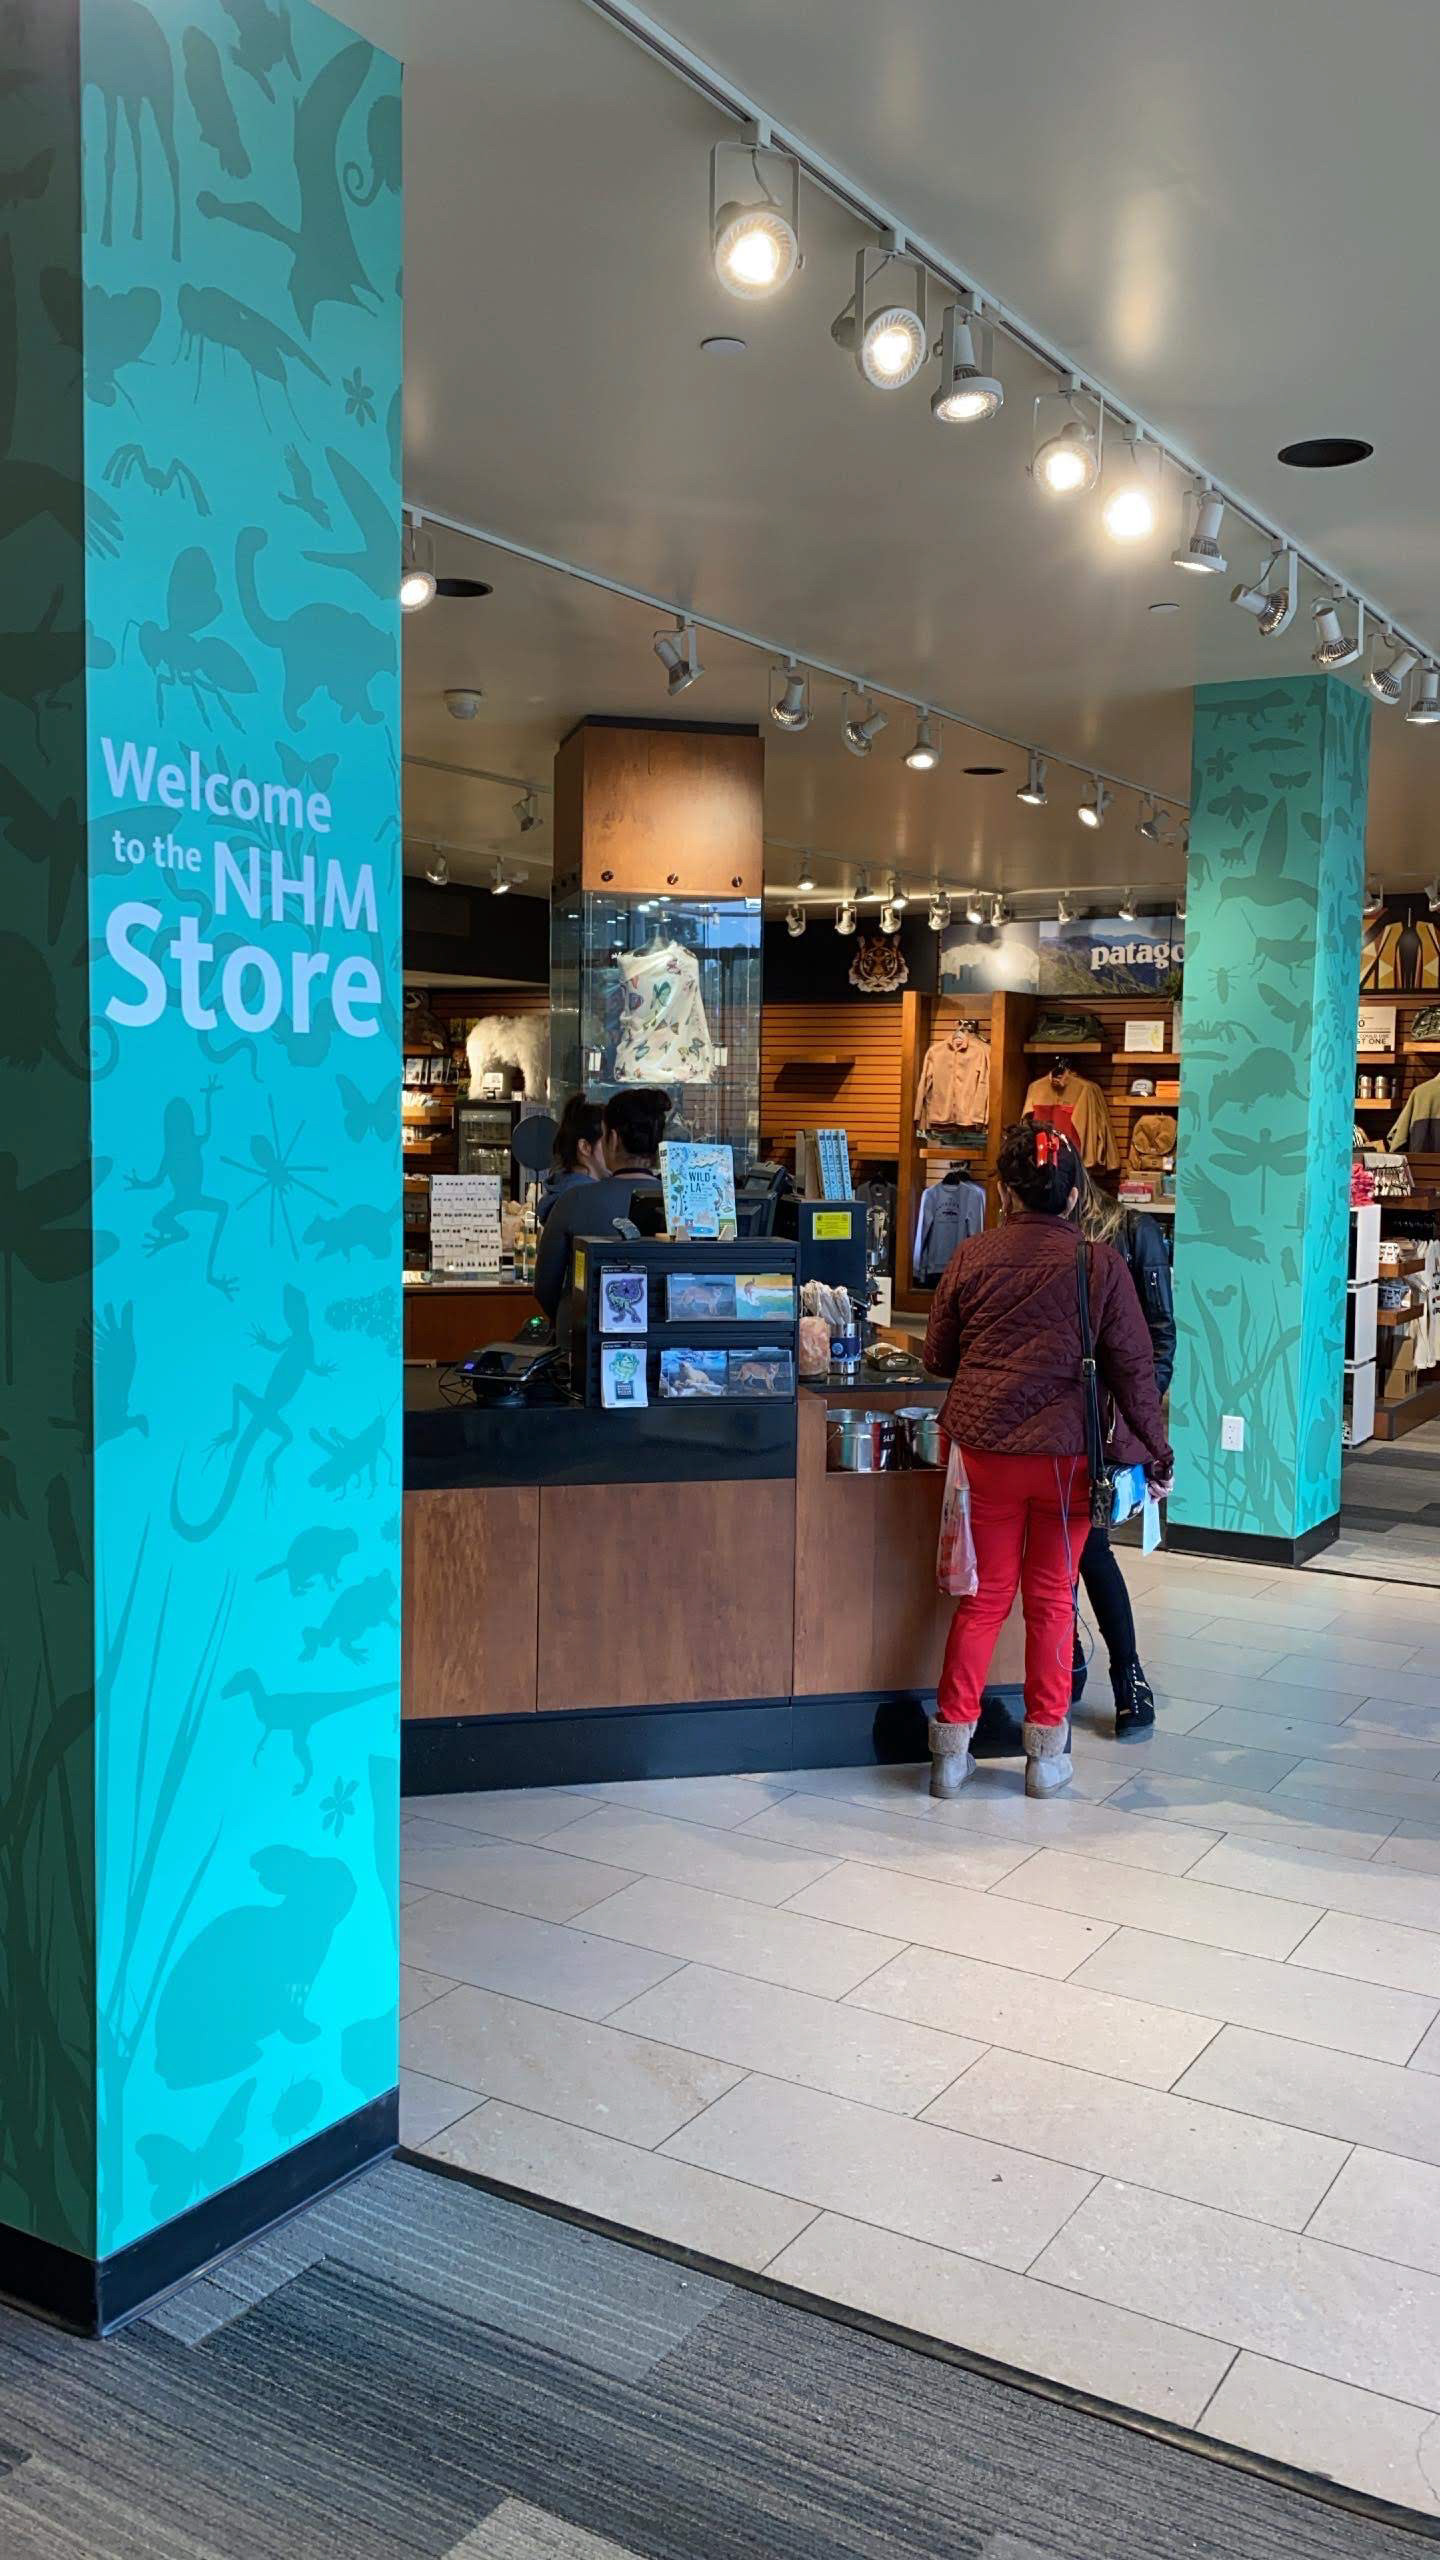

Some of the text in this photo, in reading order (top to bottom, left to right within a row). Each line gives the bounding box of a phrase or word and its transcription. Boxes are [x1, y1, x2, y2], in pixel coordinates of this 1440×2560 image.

[101, 737, 332, 833] Welcome
[112, 830, 379, 933] to the NHM
[105, 902, 382, 1038] Store
[1090, 942, 1184, 970] patago
[688, 1171, 711, 1183] WILD
[690, 1182, 702, 1193] LA
